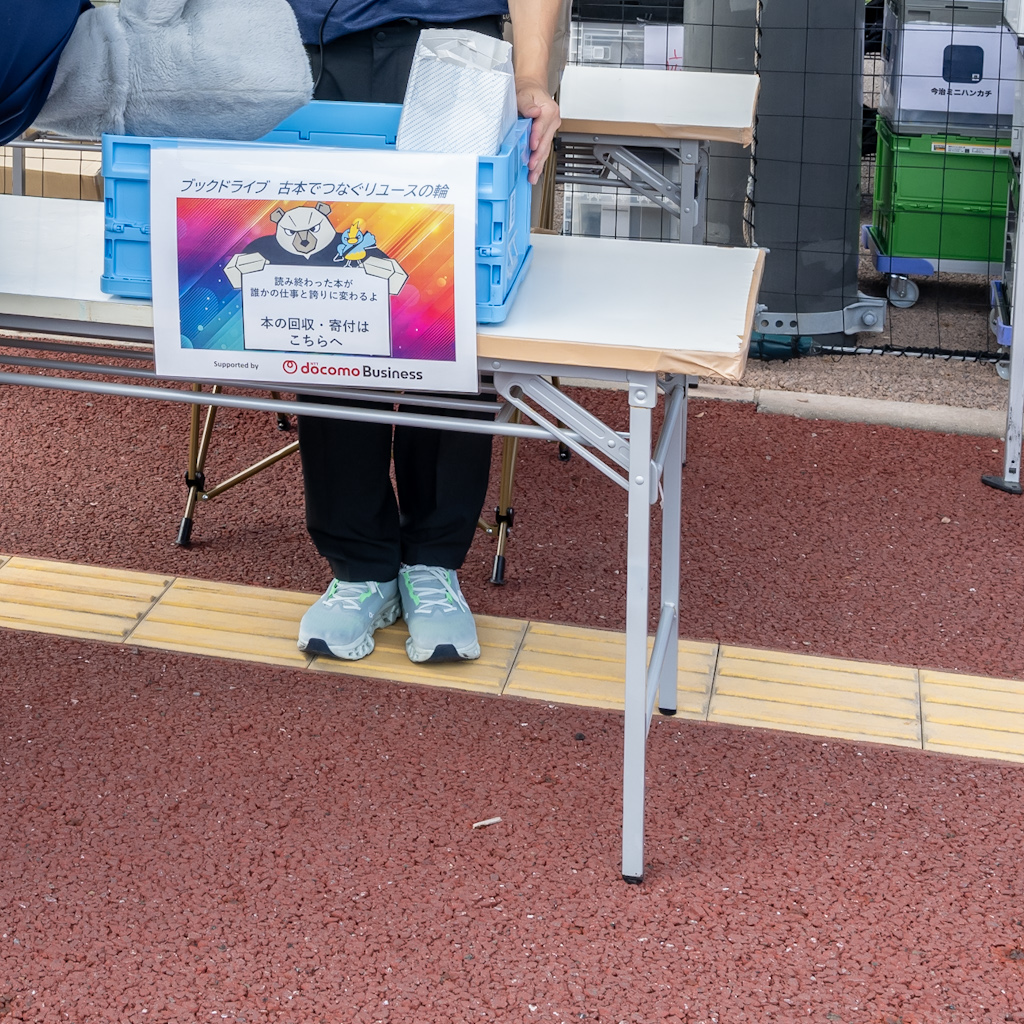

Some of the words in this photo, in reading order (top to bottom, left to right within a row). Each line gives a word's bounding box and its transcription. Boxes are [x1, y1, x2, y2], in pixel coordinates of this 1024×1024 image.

[930, 87, 992, 98] 今治ミニハンカチ
[180, 178, 271, 195] ブックドライブ
[277, 180, 450, 199] 古本でつなぐリユースの輪
[274, 276, 354, 289] 読み終わった本が
[250, 287, 378, 302] 誰かの仕事と誇りに変わるよ
[260, 316, 370, 333] 本の回収・寄付は
[290, 334, 343, 347] こちらへ
[213, 360, 249, 369] Supported
[250, 362, 259, 370] by
[300, 361, 361, 377] docomo
[362, 365, 423, 380] Business
